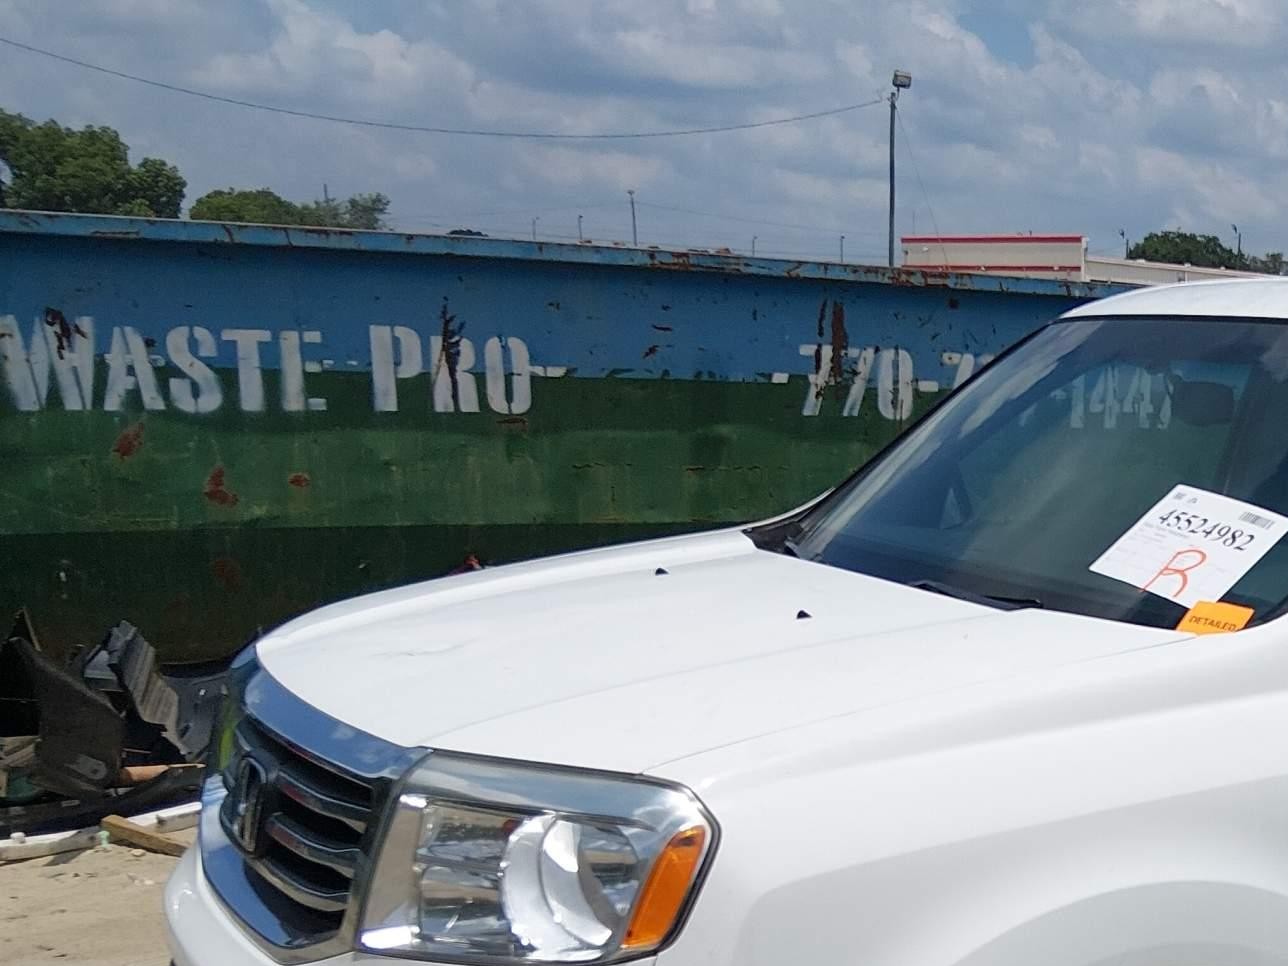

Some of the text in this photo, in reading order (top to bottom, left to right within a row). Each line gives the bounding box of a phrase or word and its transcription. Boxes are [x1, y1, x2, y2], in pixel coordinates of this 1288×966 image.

[0, 314, 328, 414] WASTE
[1158, 508, 1256, 552] 45524982
[1139, 546, 1208, 598] R
[1188, 615, 1237, 632] DETAILED
